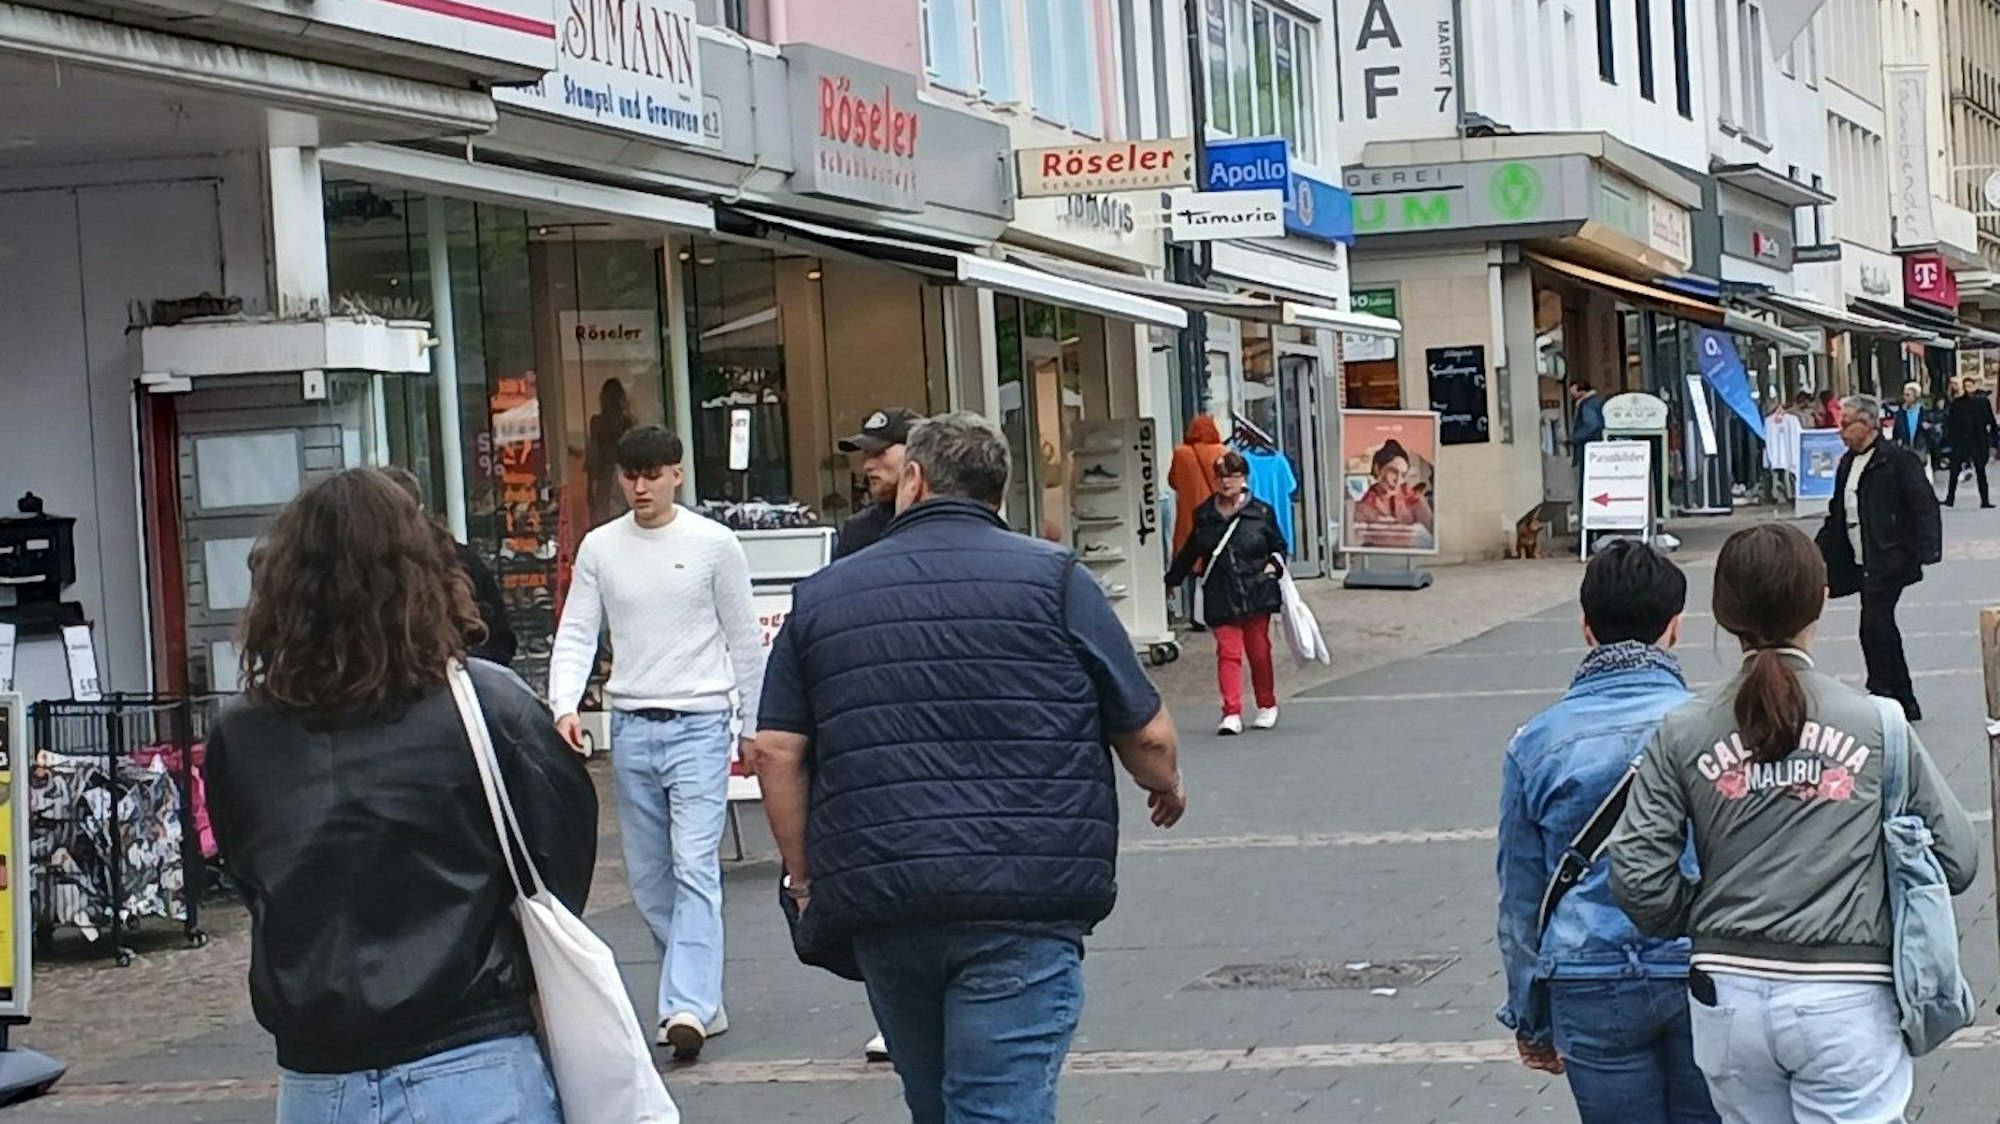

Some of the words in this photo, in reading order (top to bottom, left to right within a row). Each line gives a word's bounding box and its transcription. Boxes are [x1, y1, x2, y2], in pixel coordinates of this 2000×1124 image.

[1437, 19, 1453, 77] MARKT
[563, 74, 614, 118] Stempel
[619, 87, 641, 120] und
[646, 94, 699, 134] Gravuren
[818, 74, 920, 159] Röseler
[1434, 86, 1453, 113] 7
[1042, 144, 1175, 178] Röseler
[1210, 158, 1286, 188] Apollo
[575, 324, 643, 341] Röseler
[1697, 721, 1871, 781] CALRNIA
[1745, 759, 1821, 791] MALIBU
